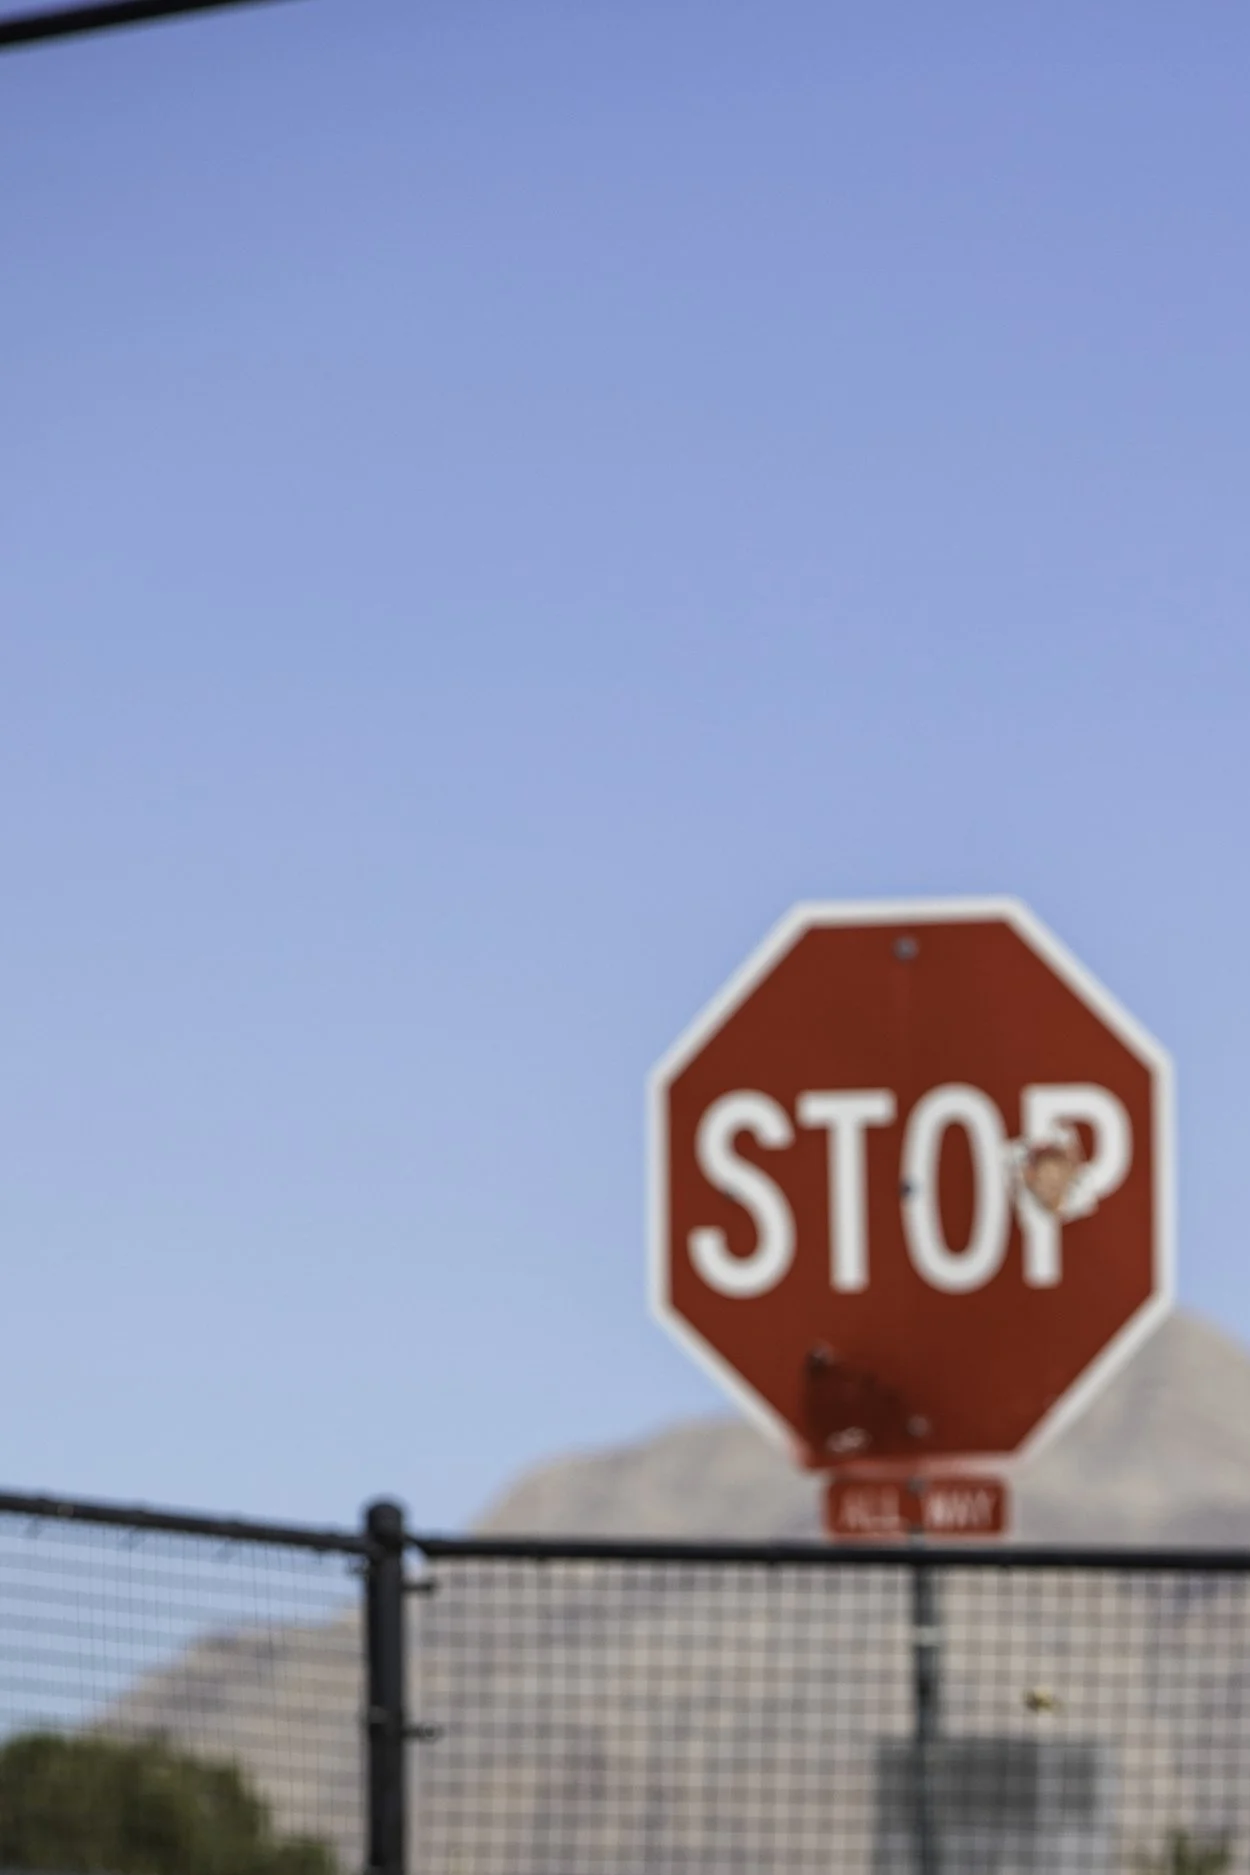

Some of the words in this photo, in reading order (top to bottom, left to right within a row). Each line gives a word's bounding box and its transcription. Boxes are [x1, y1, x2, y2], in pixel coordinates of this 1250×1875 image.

[687, 1082, 1133, 1299] STOP
[838, 1485, 908, 1532] ALL
[919, 1486, 997, 1530] WAY
